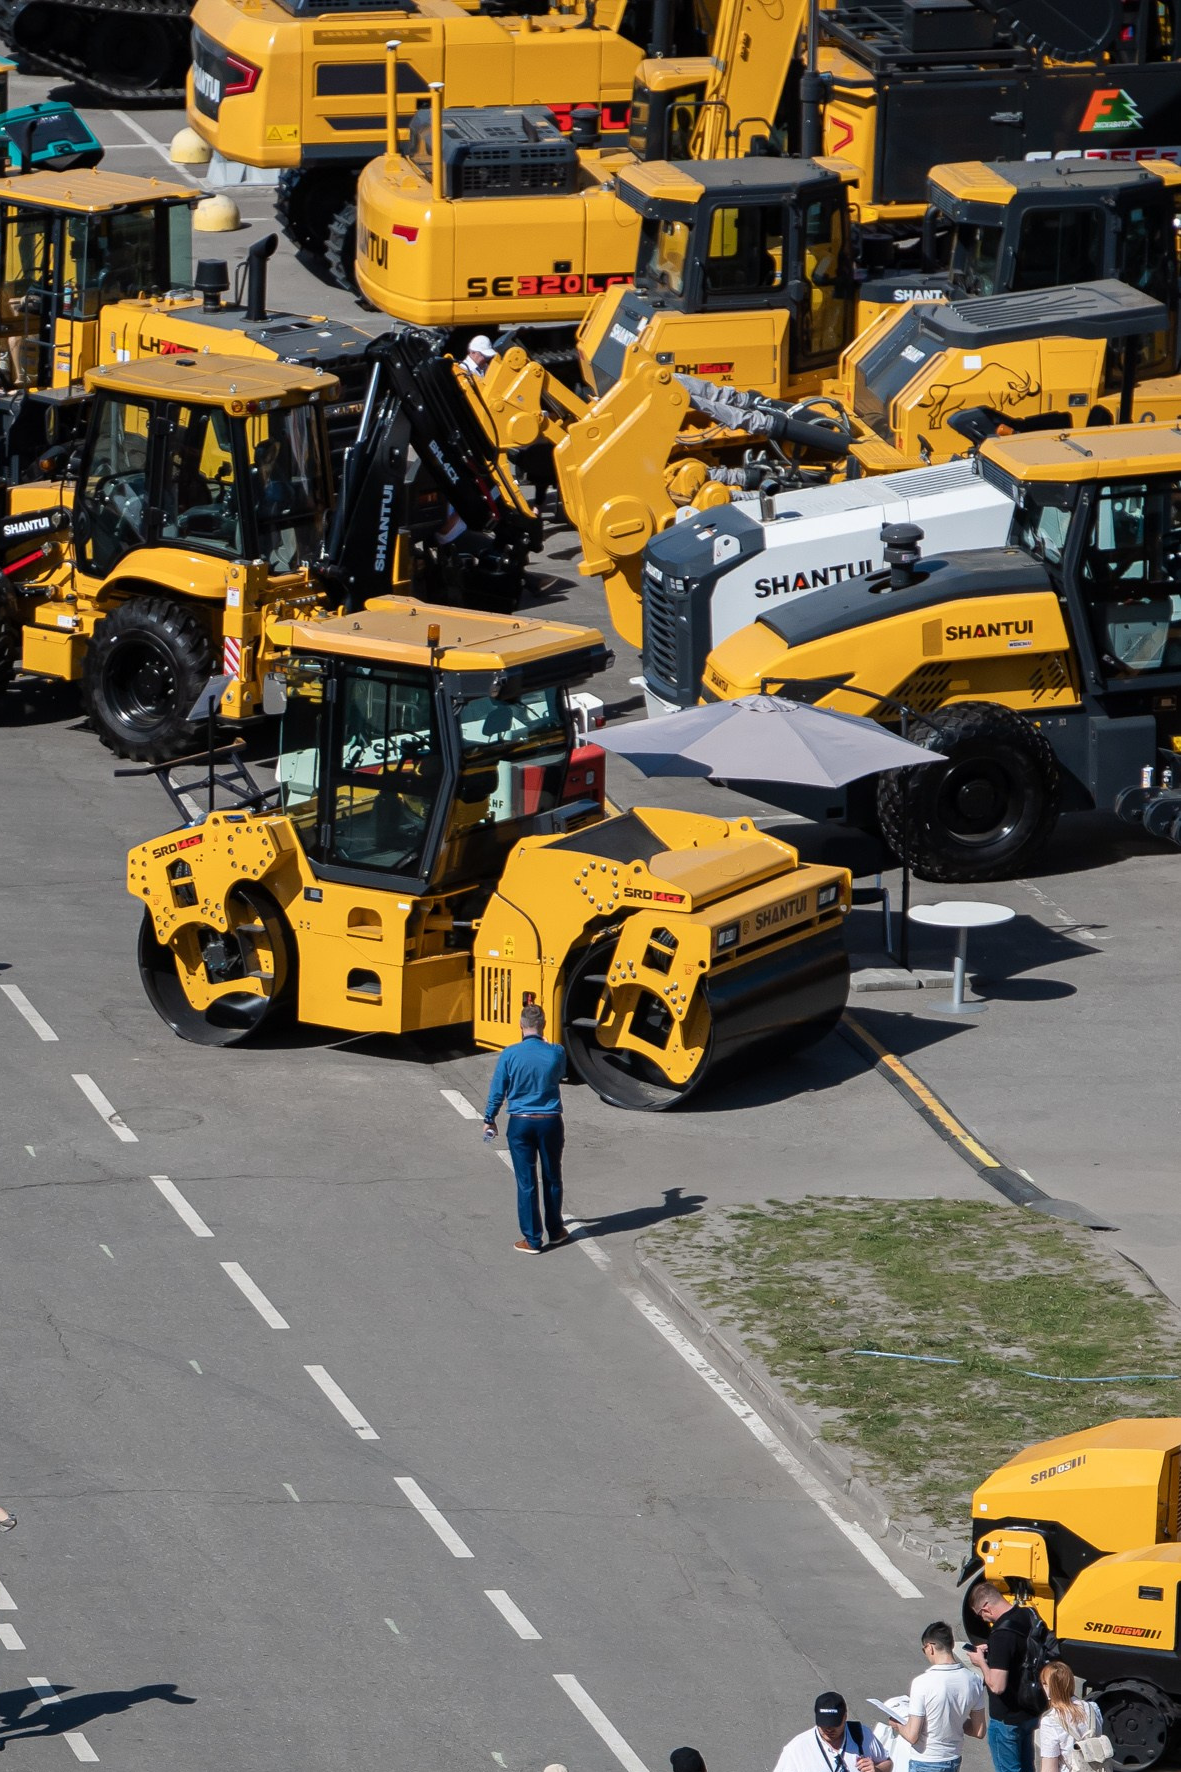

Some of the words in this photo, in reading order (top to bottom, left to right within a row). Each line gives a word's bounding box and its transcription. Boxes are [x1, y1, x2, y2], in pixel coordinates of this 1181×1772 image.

[3, 517, 50, 535] SHANTUI
[375, 484, 394, 572] SHANTUI
[755, 559, 873, 598] SHANTUI
[945, 620, 1034, 641] SHANTUI
[755, 895, 807, 931] SHANTUI
